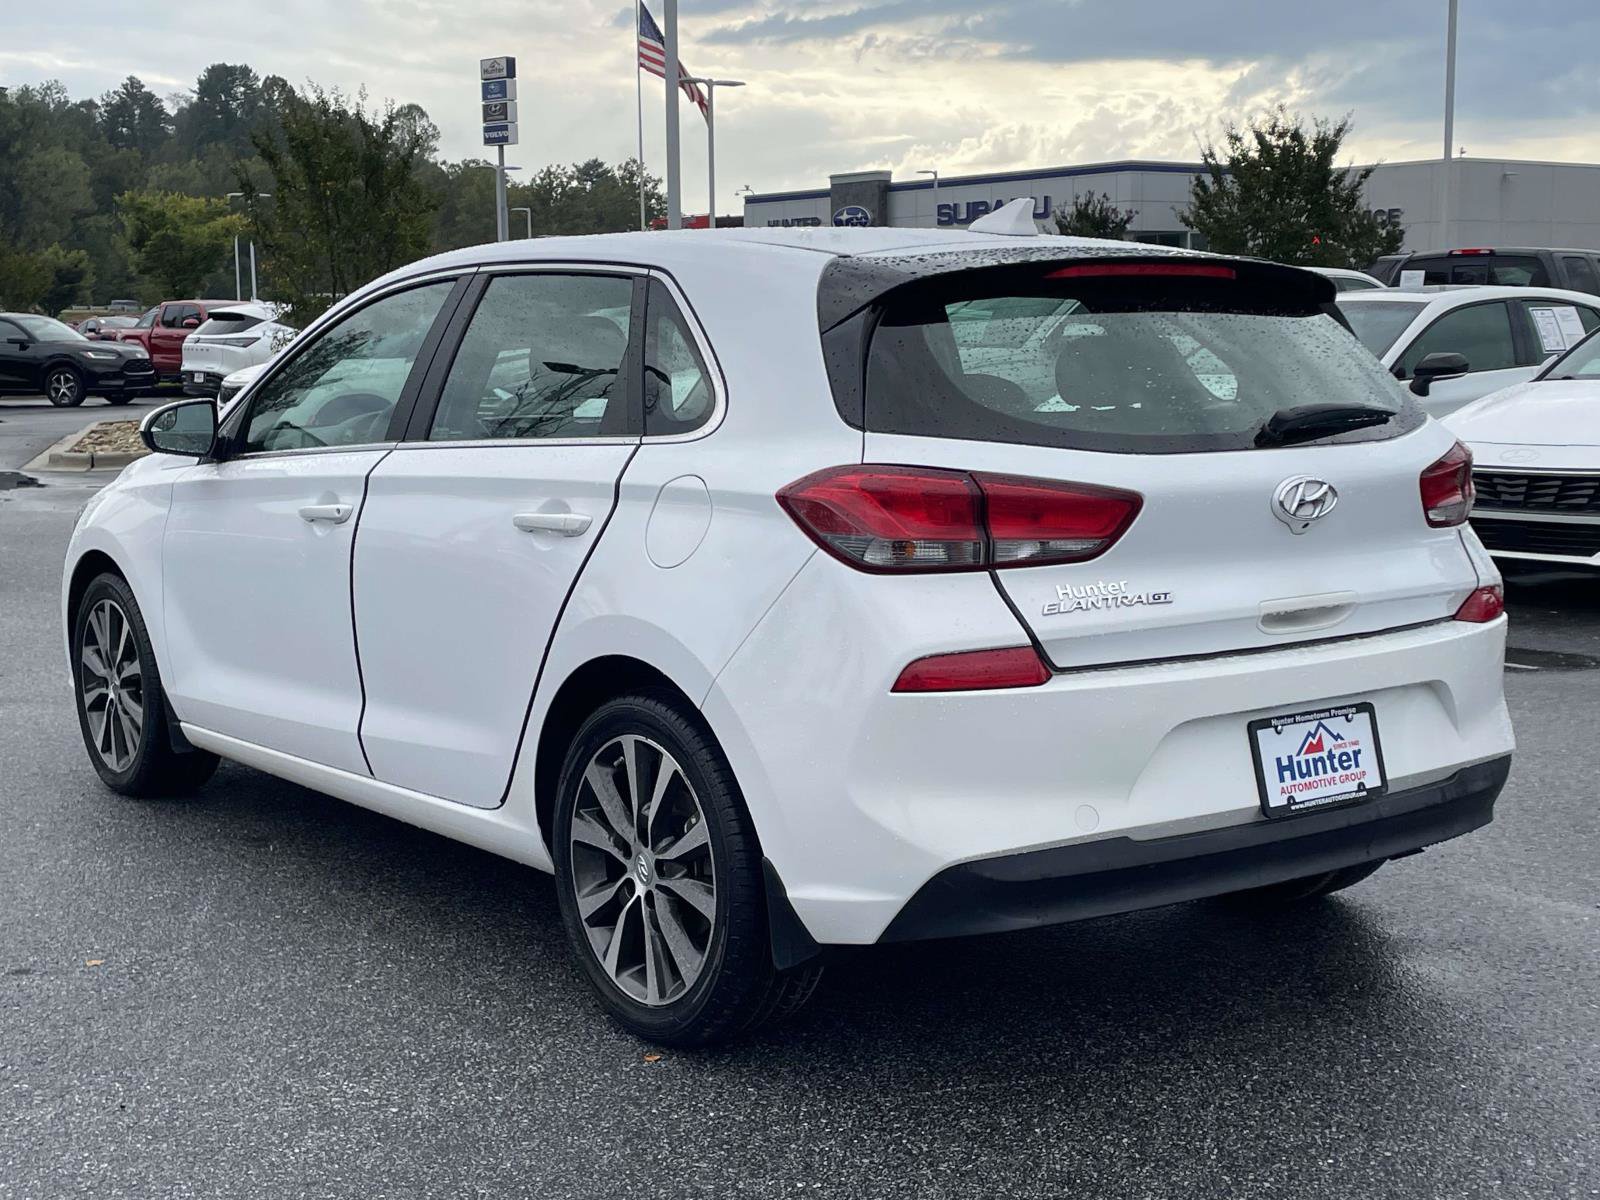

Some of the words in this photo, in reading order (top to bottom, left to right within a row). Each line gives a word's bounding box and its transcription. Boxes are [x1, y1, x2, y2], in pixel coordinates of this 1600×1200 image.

[483, 66, 504, 74] Hunter
[937, 195, 1052, 226] SUBU
[1055, 580, 1128, 601] Hunter
[1042, 594, 1147, 616] ELANTRA
[1271, 717, 1295, 727] Hunter
[1295, 711, 1330, 723] Hometown
[1330, 706, 1357, 717] Promise
[1275, 748, 1362, 784] Hunter
[1280, 776, 1338, 796] AUTOMOTIVE
[1339, 770, 1367, 784] GROUP
